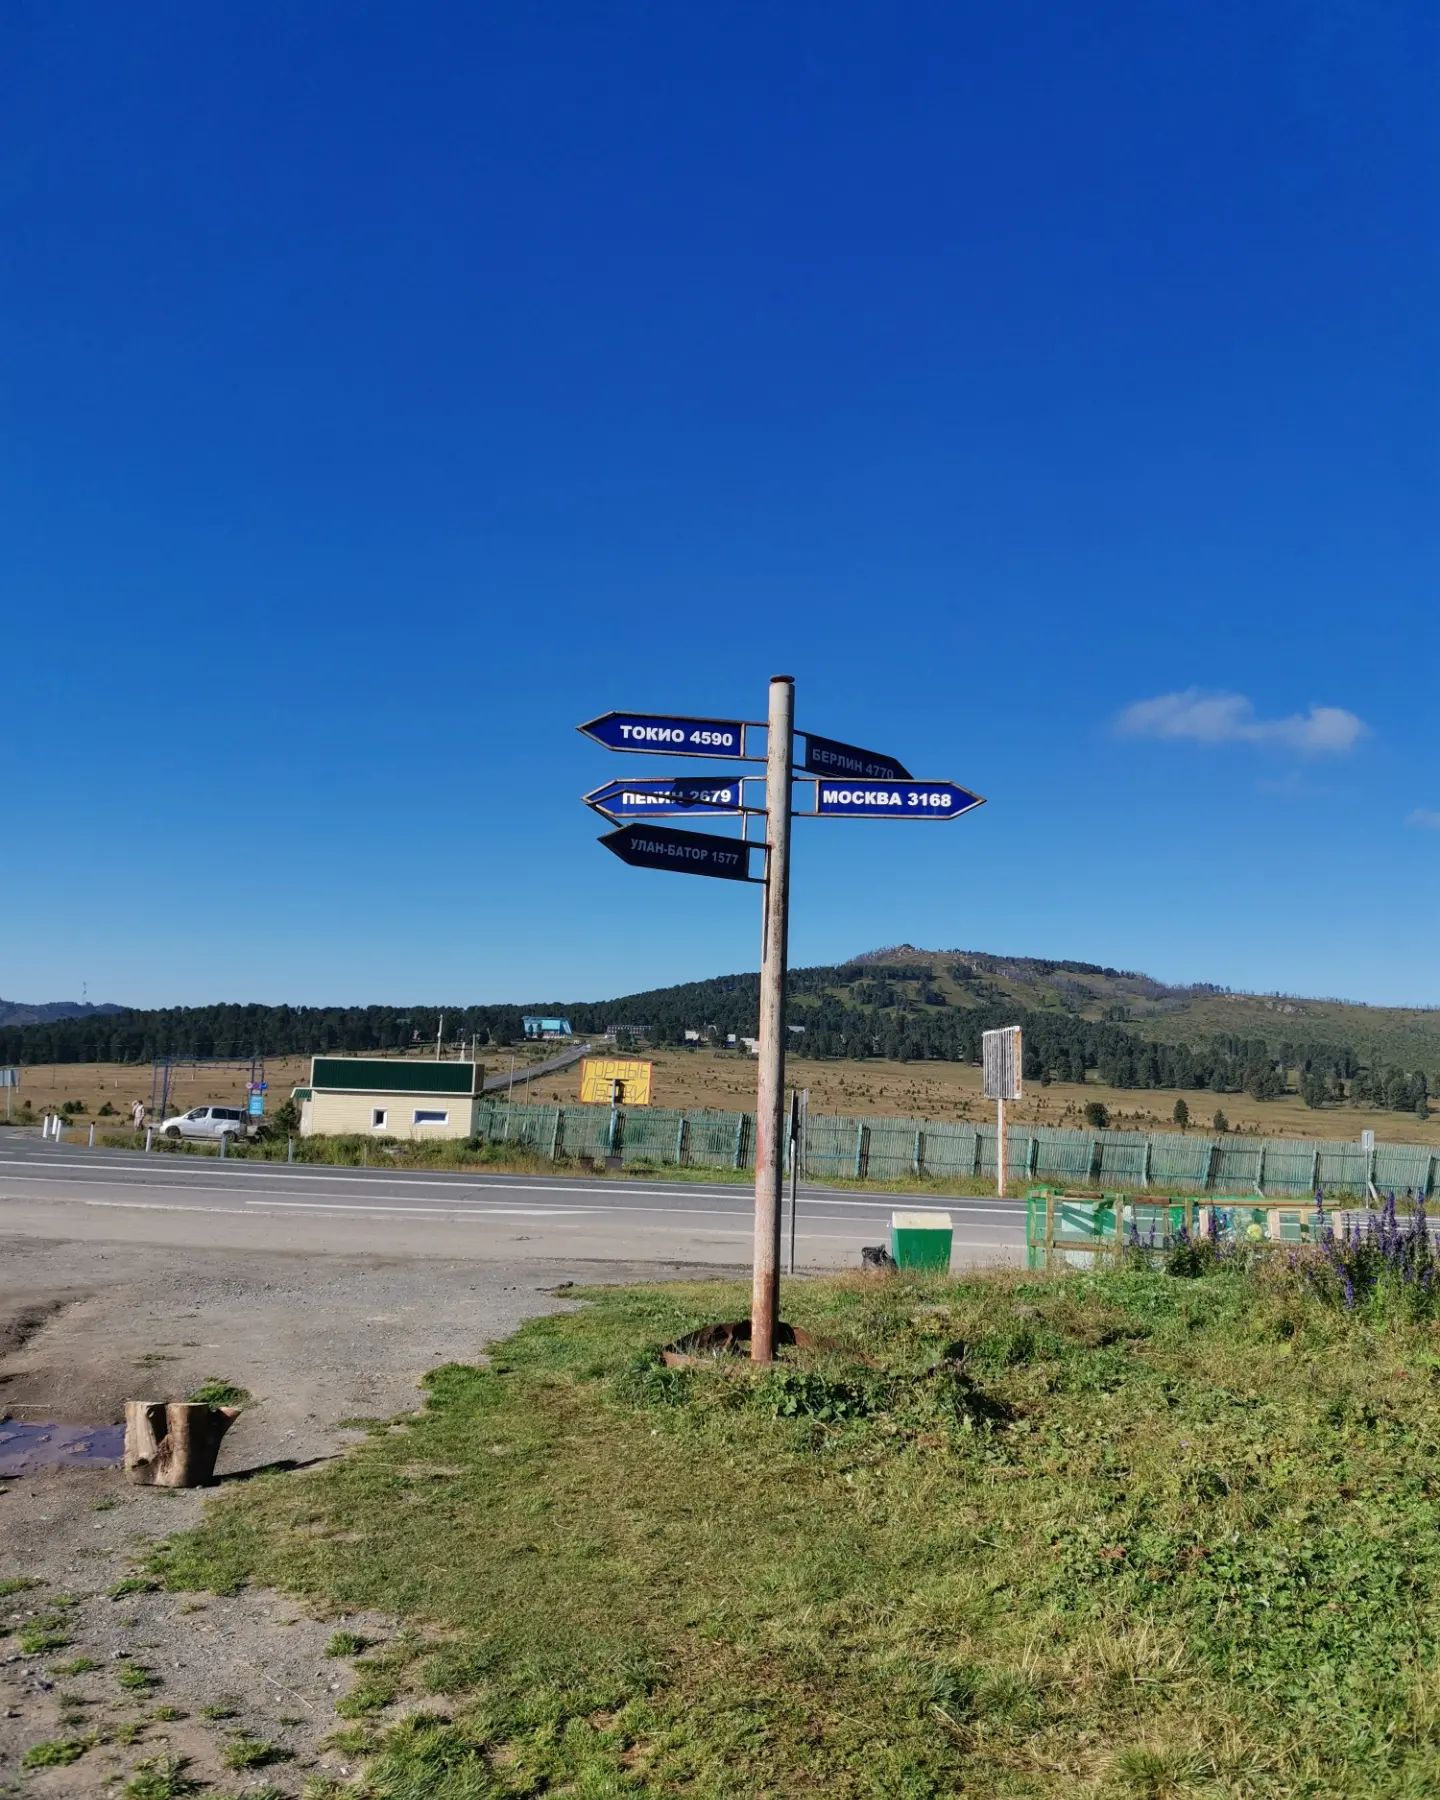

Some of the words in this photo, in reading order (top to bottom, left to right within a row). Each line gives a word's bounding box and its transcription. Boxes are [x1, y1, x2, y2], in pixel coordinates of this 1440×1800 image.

[620, 725, 685, 743] ТОКИО
[689, 730, 733, 747] 4590
[812, 749, 863, 773] БЕРЛИН
[865, 763, 895, 780] 4770
[823, 790, 902, 806] МОСКВА
[907, 792, 952, 807] 3168
[630, 838, 708, 860] УЛАН-БАТОР
[711, 850, 740, 865] 1577
